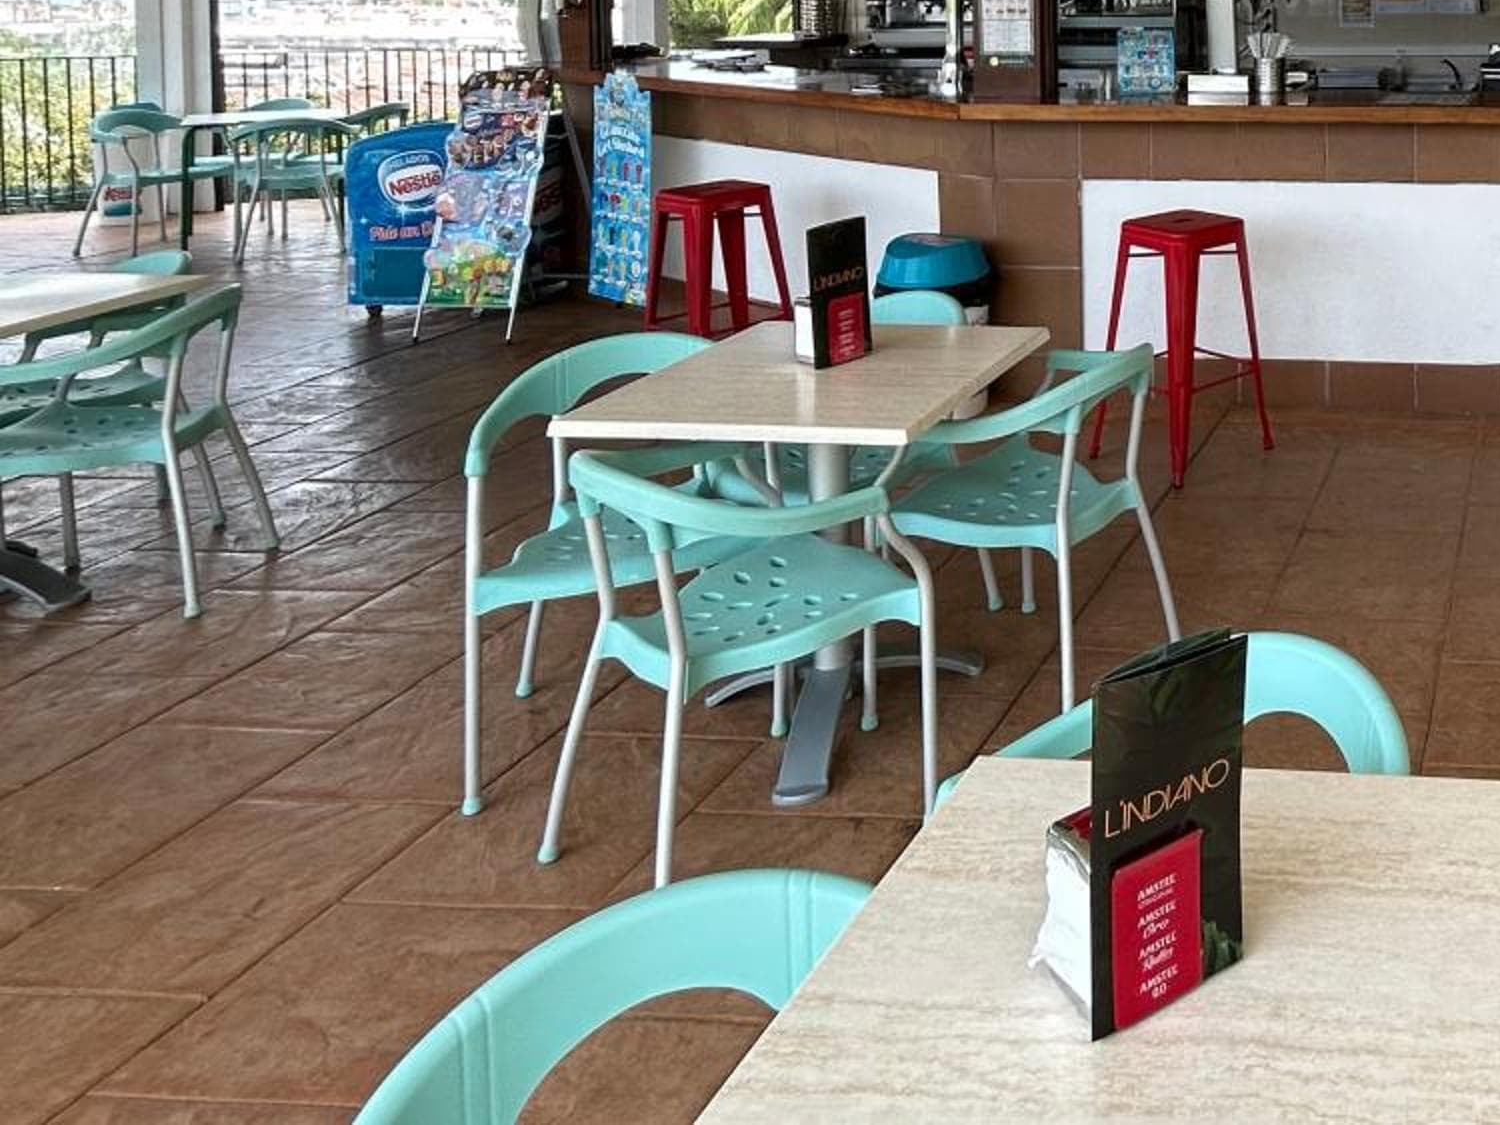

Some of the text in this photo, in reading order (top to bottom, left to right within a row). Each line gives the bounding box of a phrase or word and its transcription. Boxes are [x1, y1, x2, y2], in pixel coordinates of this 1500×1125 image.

[1103, 758, 1230, 839] L'INDIANO
[1137, 873, 1178, 902] AMSTEL
[1137, 899, 1177, 929] AMSTEL
[1138, 930, 1177, 961] AMSTEL
[1139, 963, 1179, 996] AMSTEL
